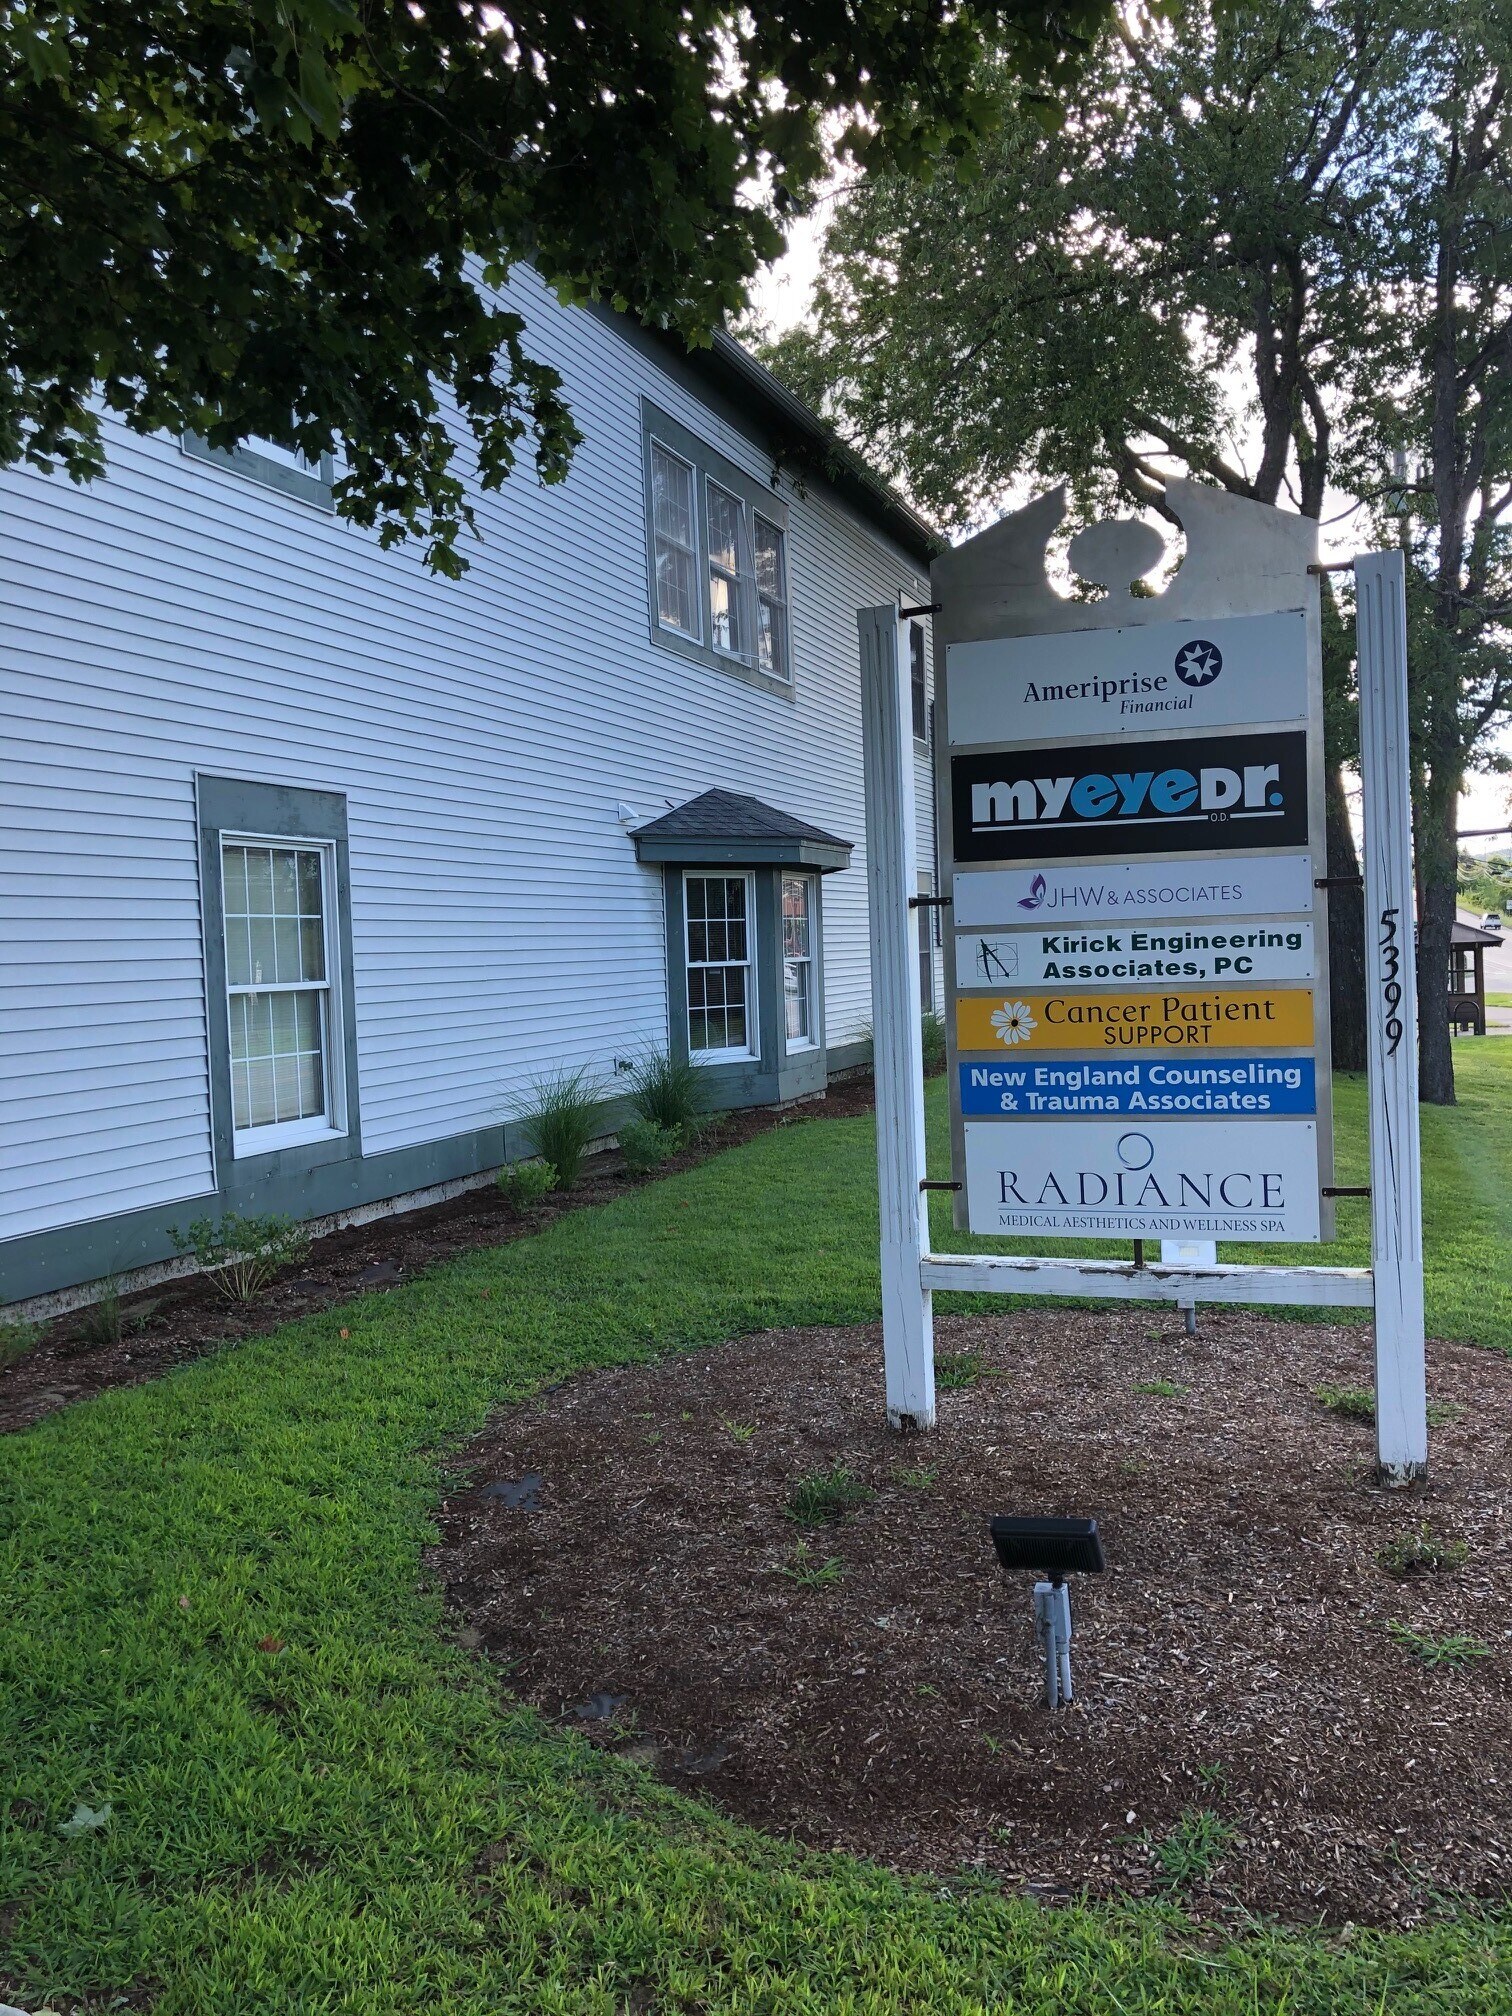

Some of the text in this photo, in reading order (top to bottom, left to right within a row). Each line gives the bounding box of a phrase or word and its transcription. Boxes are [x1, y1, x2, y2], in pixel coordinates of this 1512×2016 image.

[1023, 671, 1168, 703] Ameriprise
[1119, 694, 1194, 715] Financial
[1210, 812, 1230, 823] O.D.
[1046, 884, 1243, 909] JHW & ASSOCIATES
[1042, 929, 1303, 954] Kirick Engineering
[1042, 956, 1254, 980] Associates, PC
[1379, 908, 1403, 1056] 5399
[1044, 996, 1276, 1025] Cancer Patient
[1103, 1025, 1213, 1045] SUPPORT
[971, 1063, 1302, 1092] New England Counseling
[1000, 1090, 1271, 1111] & Trauma Associates
[997, 1170, 1286, 1209] RADIANCE
[998, 1214, 1286, 1232] MEDICAL AESTHETICS AND WELLNESS SPA
